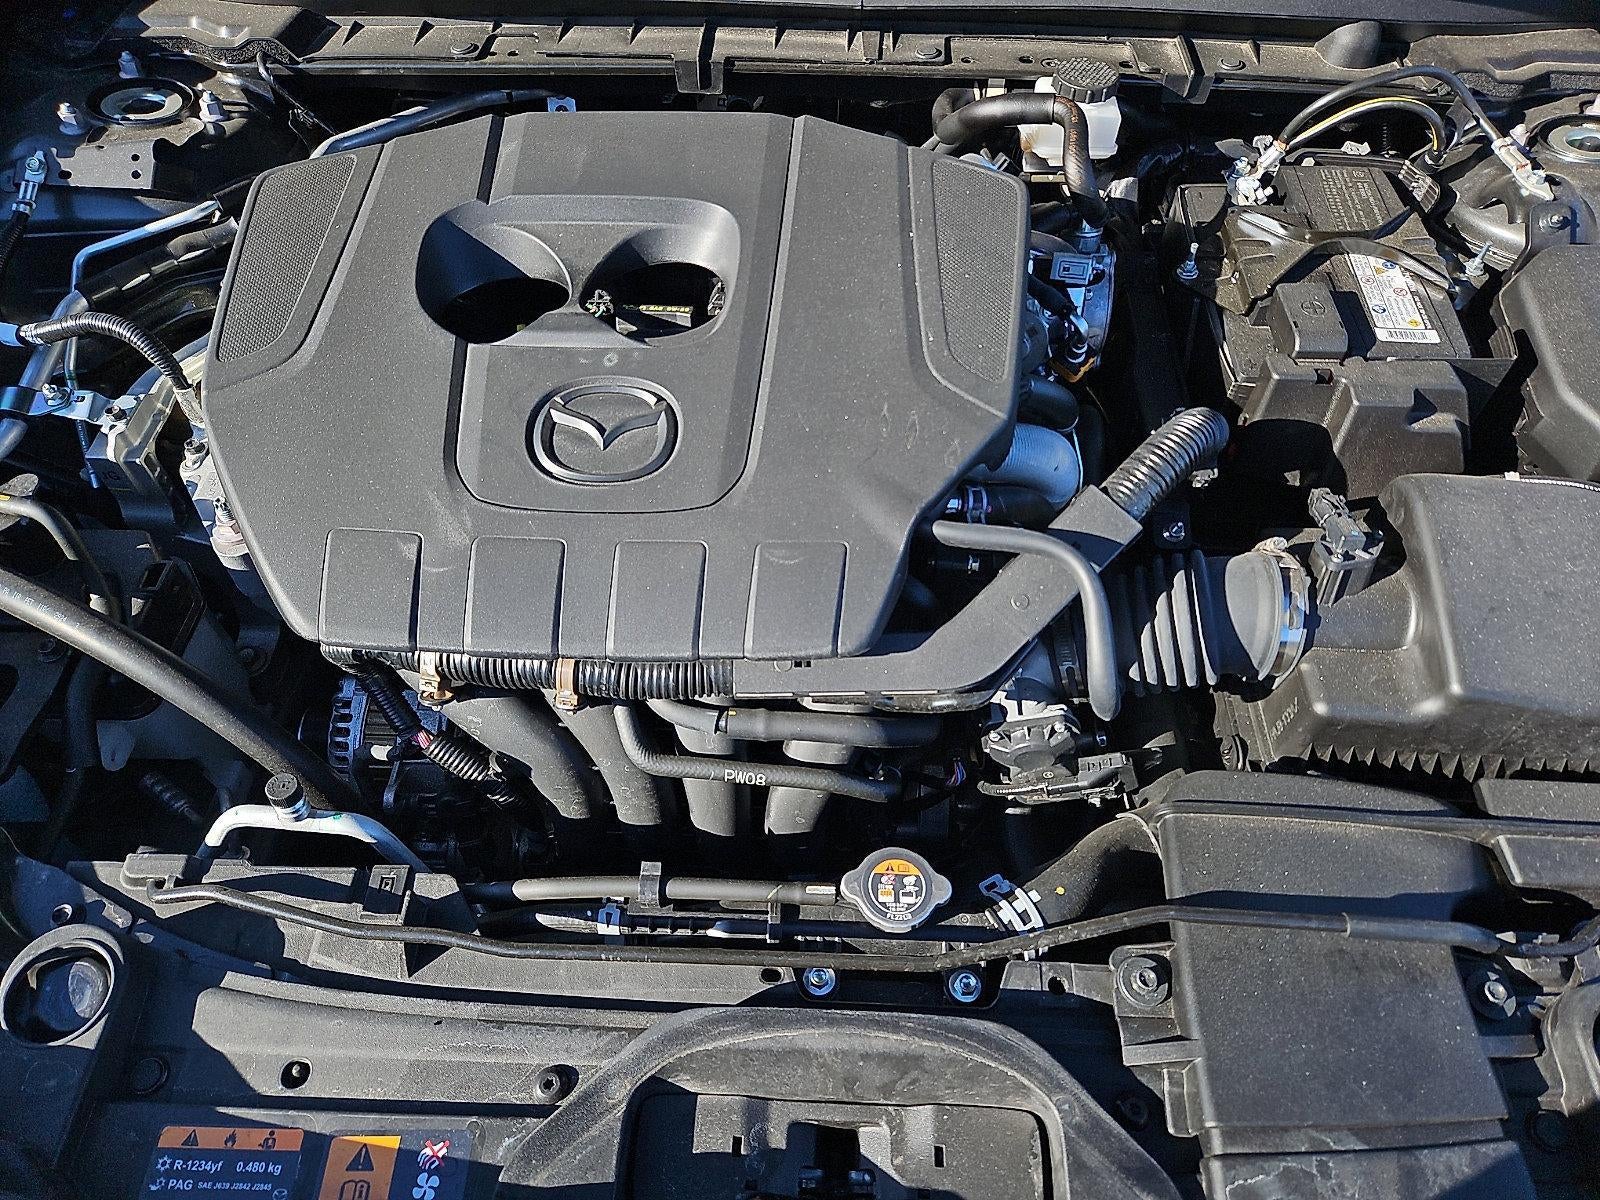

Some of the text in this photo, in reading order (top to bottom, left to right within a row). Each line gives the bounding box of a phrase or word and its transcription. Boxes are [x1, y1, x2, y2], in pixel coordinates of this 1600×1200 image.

[724, 768, 766, 786] PW08
[173, 1159, 282, 1176] R-1234yf 0.480 kg
[167, 1179, 194, 1190] PAG
[197, 1181, 212, 1189] SAE
